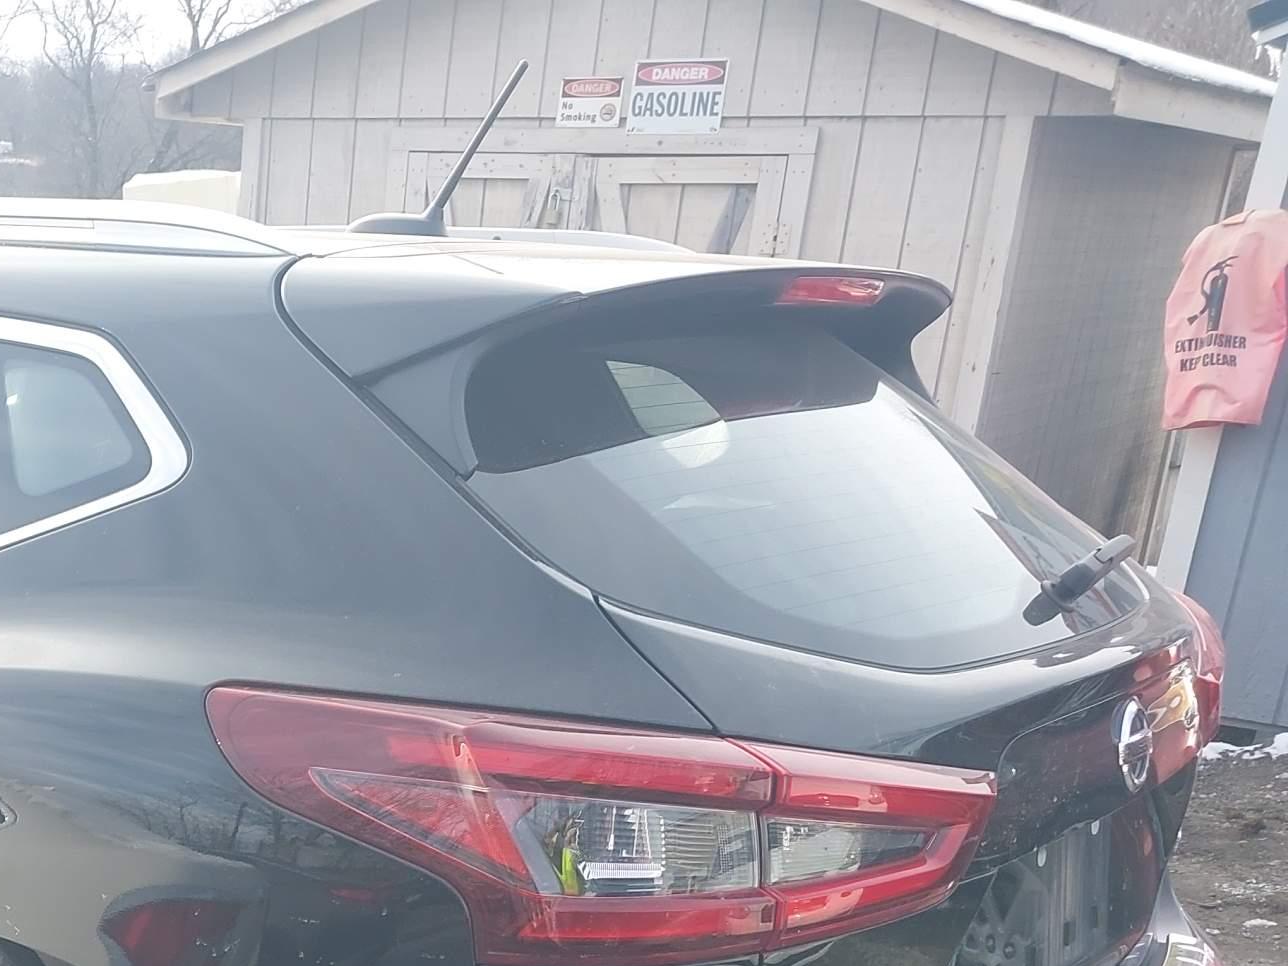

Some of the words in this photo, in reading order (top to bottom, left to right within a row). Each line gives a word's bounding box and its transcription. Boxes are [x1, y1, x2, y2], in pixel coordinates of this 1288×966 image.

[652, 67, 710, 81] DANGER
[562, 101, 573, 110] No
[631, 91, 722, 118] GASOLINE
[560, 112, 597, 124] Smoking
[1175, 333, 1247, 353] EXTIUISHER
[1202, 353, 1237, 367] CLEAR
